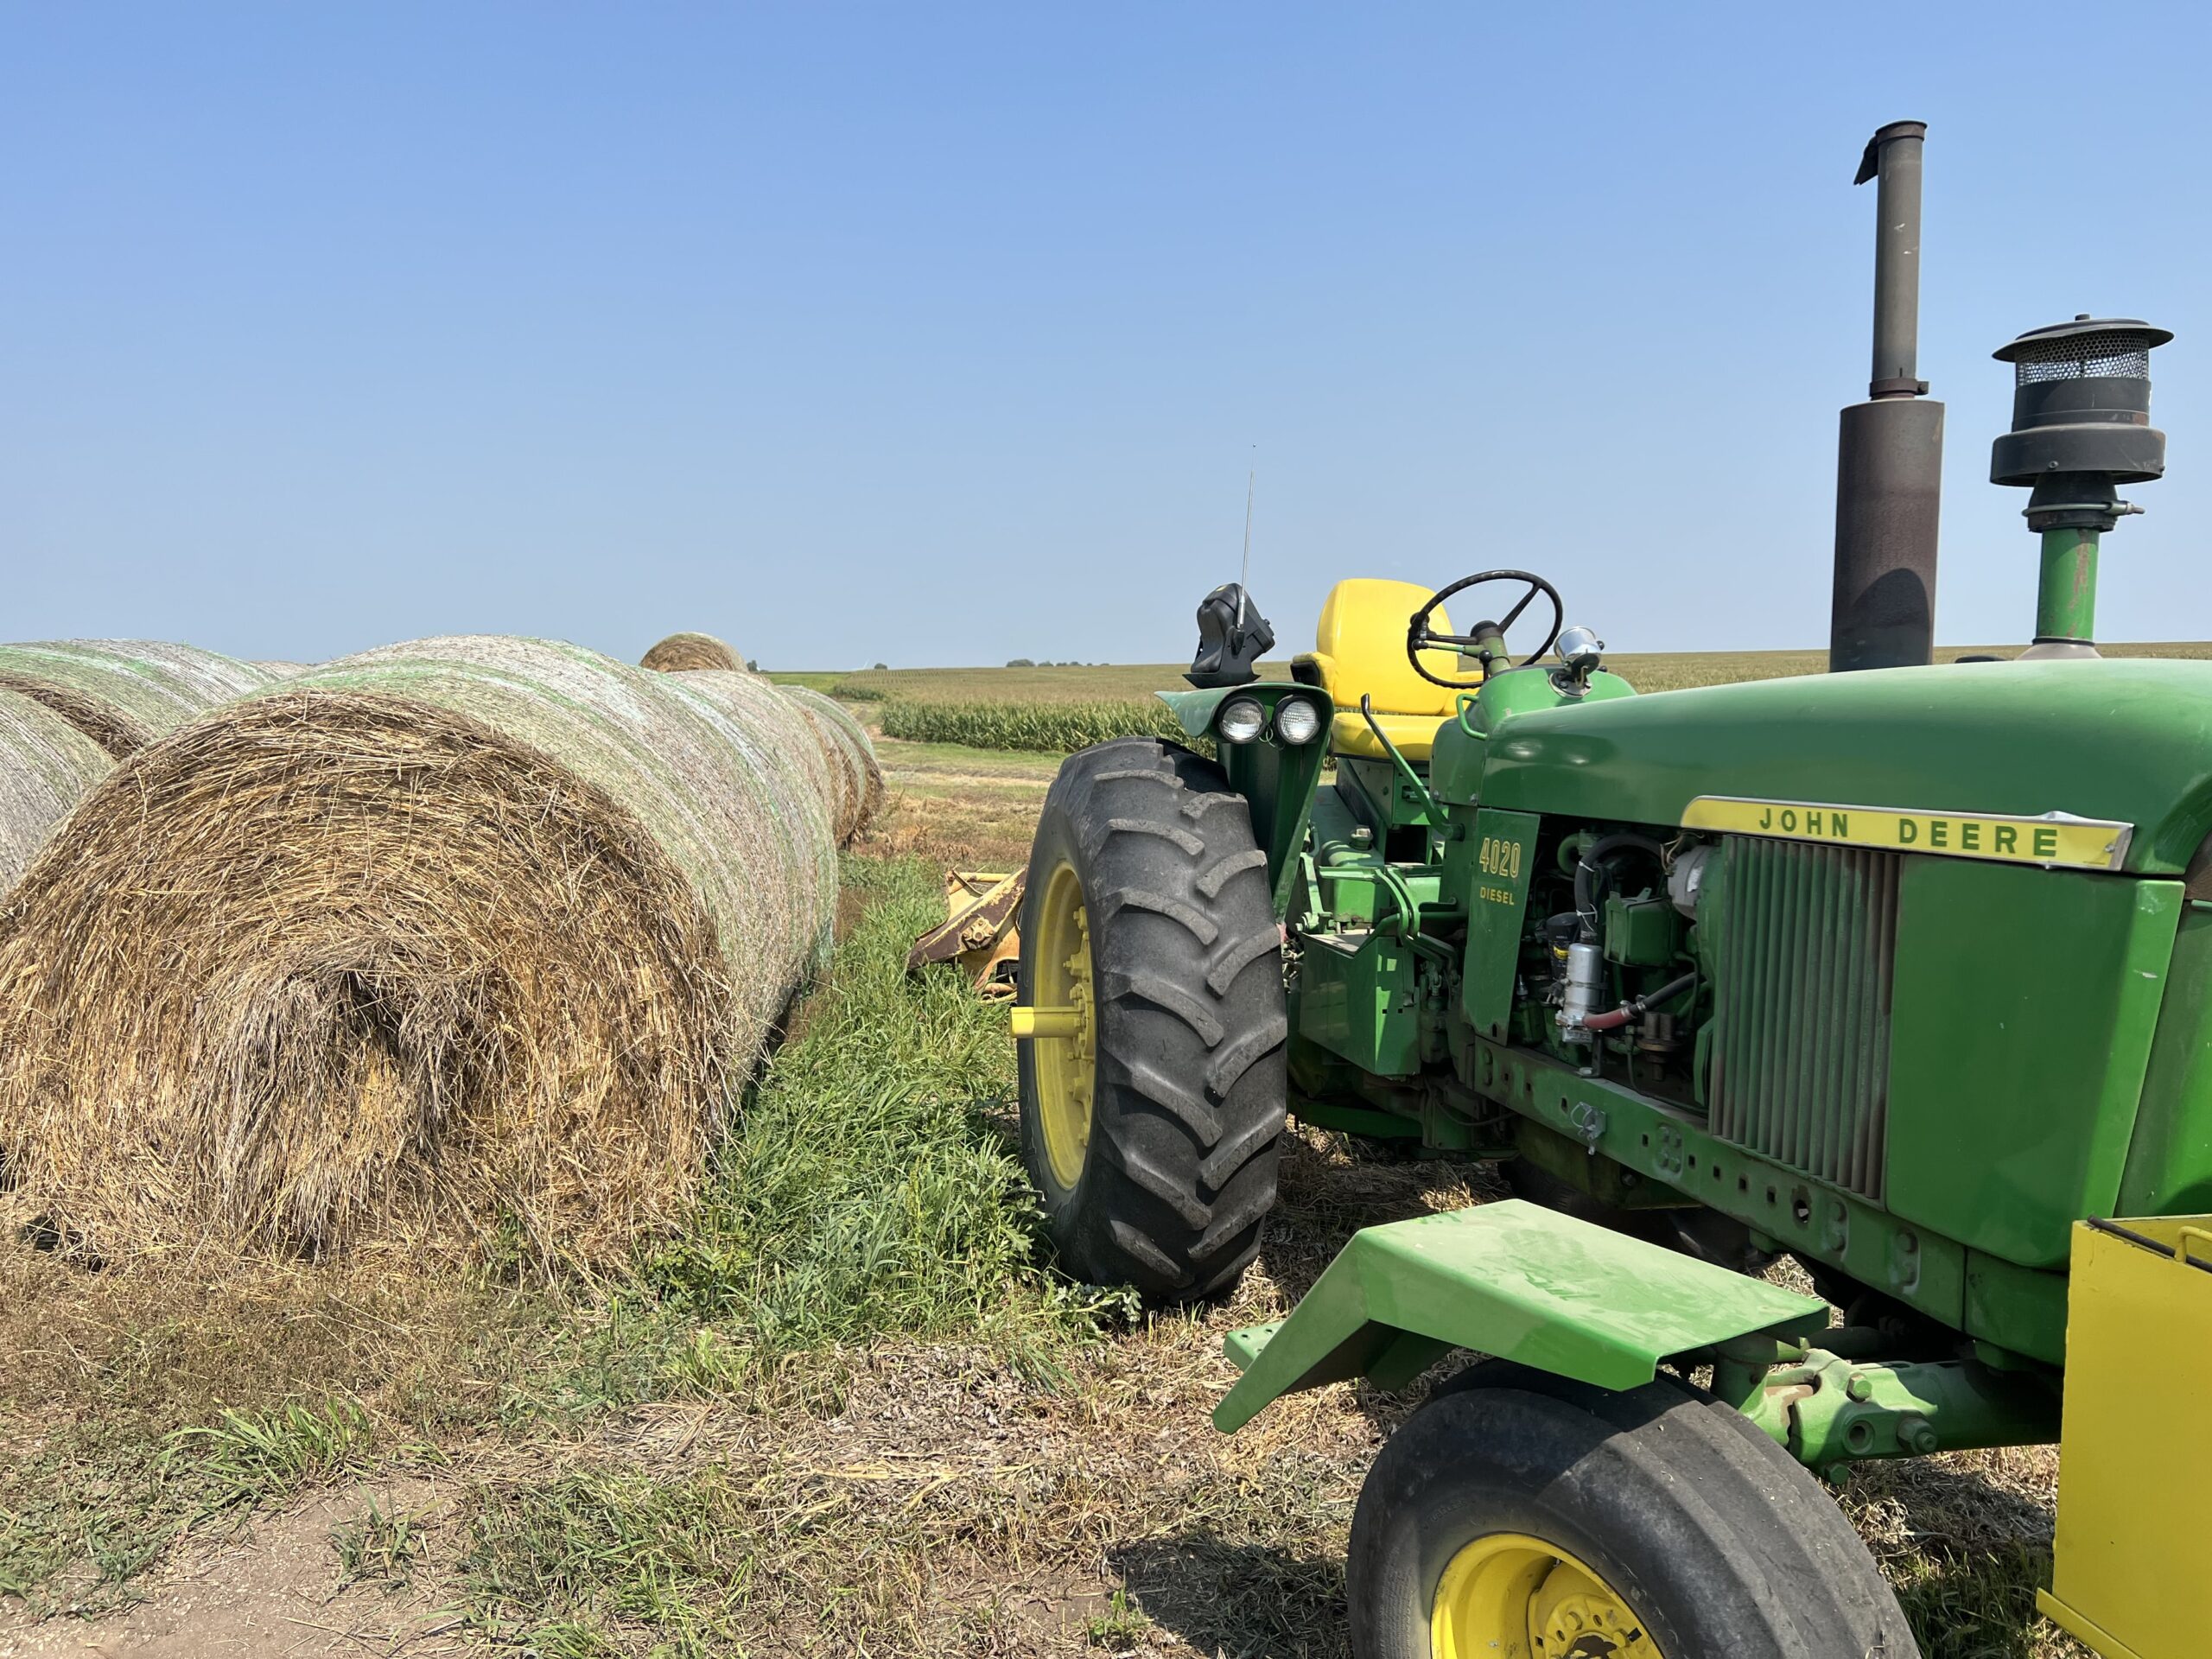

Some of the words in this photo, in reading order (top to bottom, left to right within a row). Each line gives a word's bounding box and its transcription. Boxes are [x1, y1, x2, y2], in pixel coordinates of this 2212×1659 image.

[1759, 808, 1848, 837] JOHN
[1899, 818, 2057, 857] DEERE
[1479, 837, 1521, 878] 4020
[1480, 887, 1515, 906] DIESEL
